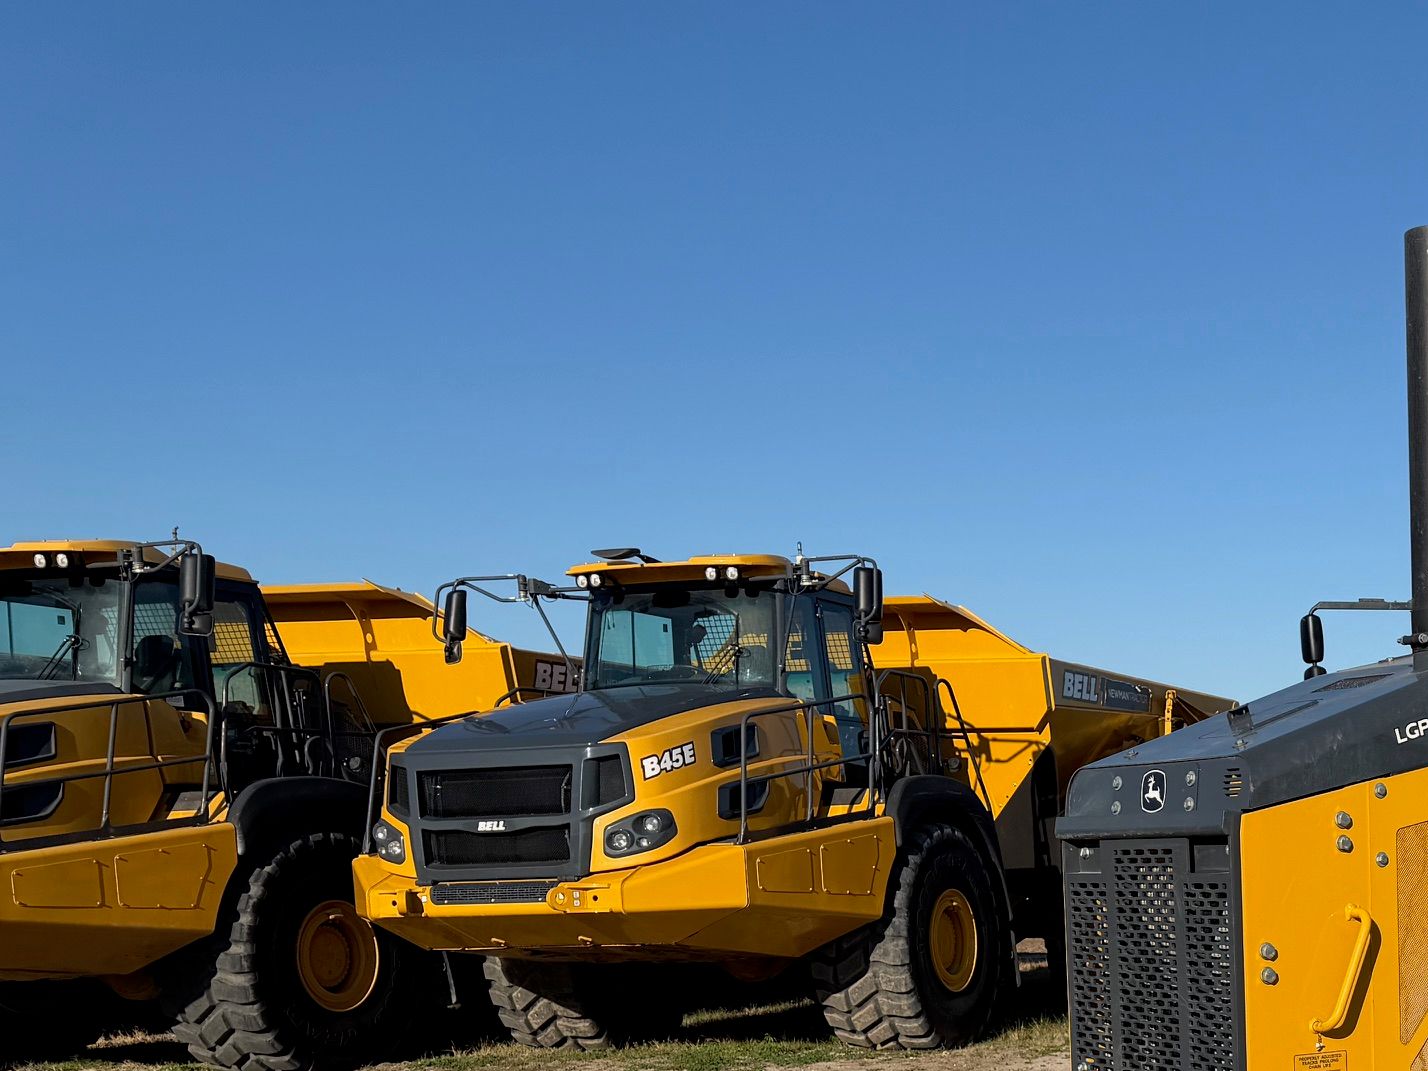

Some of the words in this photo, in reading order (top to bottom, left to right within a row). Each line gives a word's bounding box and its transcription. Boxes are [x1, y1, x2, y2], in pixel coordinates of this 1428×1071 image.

[535, 662, 579, 693] BEL
[1063, 671, 1097, 701] BELL
[641, 742, 695, 779] B45E
[478, 820, 506, 831] BELL
